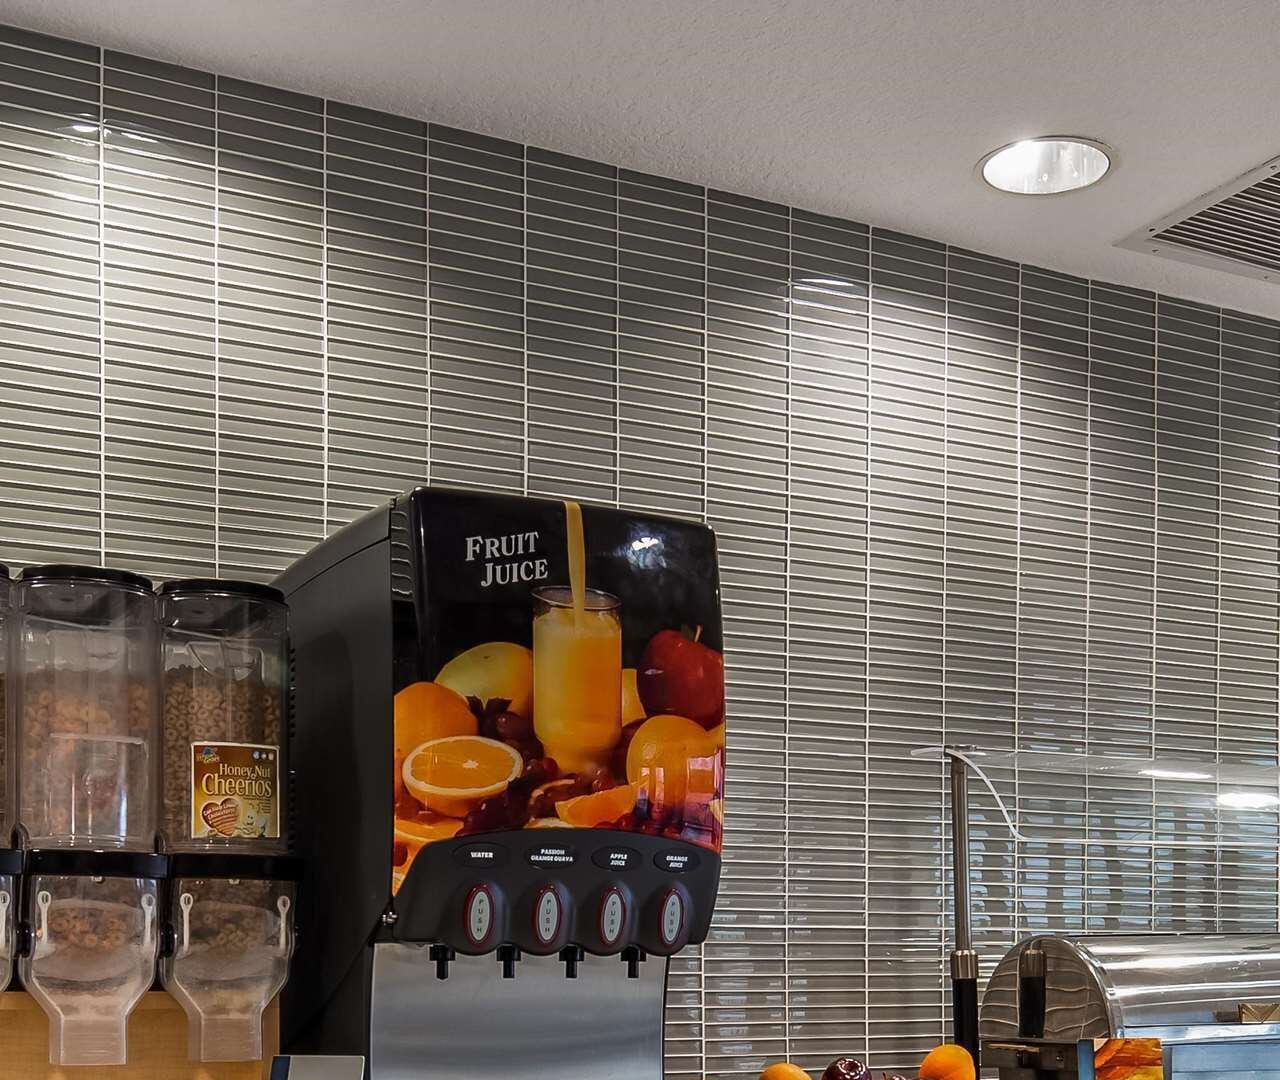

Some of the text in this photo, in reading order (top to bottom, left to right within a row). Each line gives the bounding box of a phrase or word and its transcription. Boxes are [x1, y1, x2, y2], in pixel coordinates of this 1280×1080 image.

[464, 532, 539, 561] FRUIT
[480, 559, 548, 587] JUICE
[219, 763, 271, 779] Honey Nut
[201, 772, 272, 797] Cheerios
